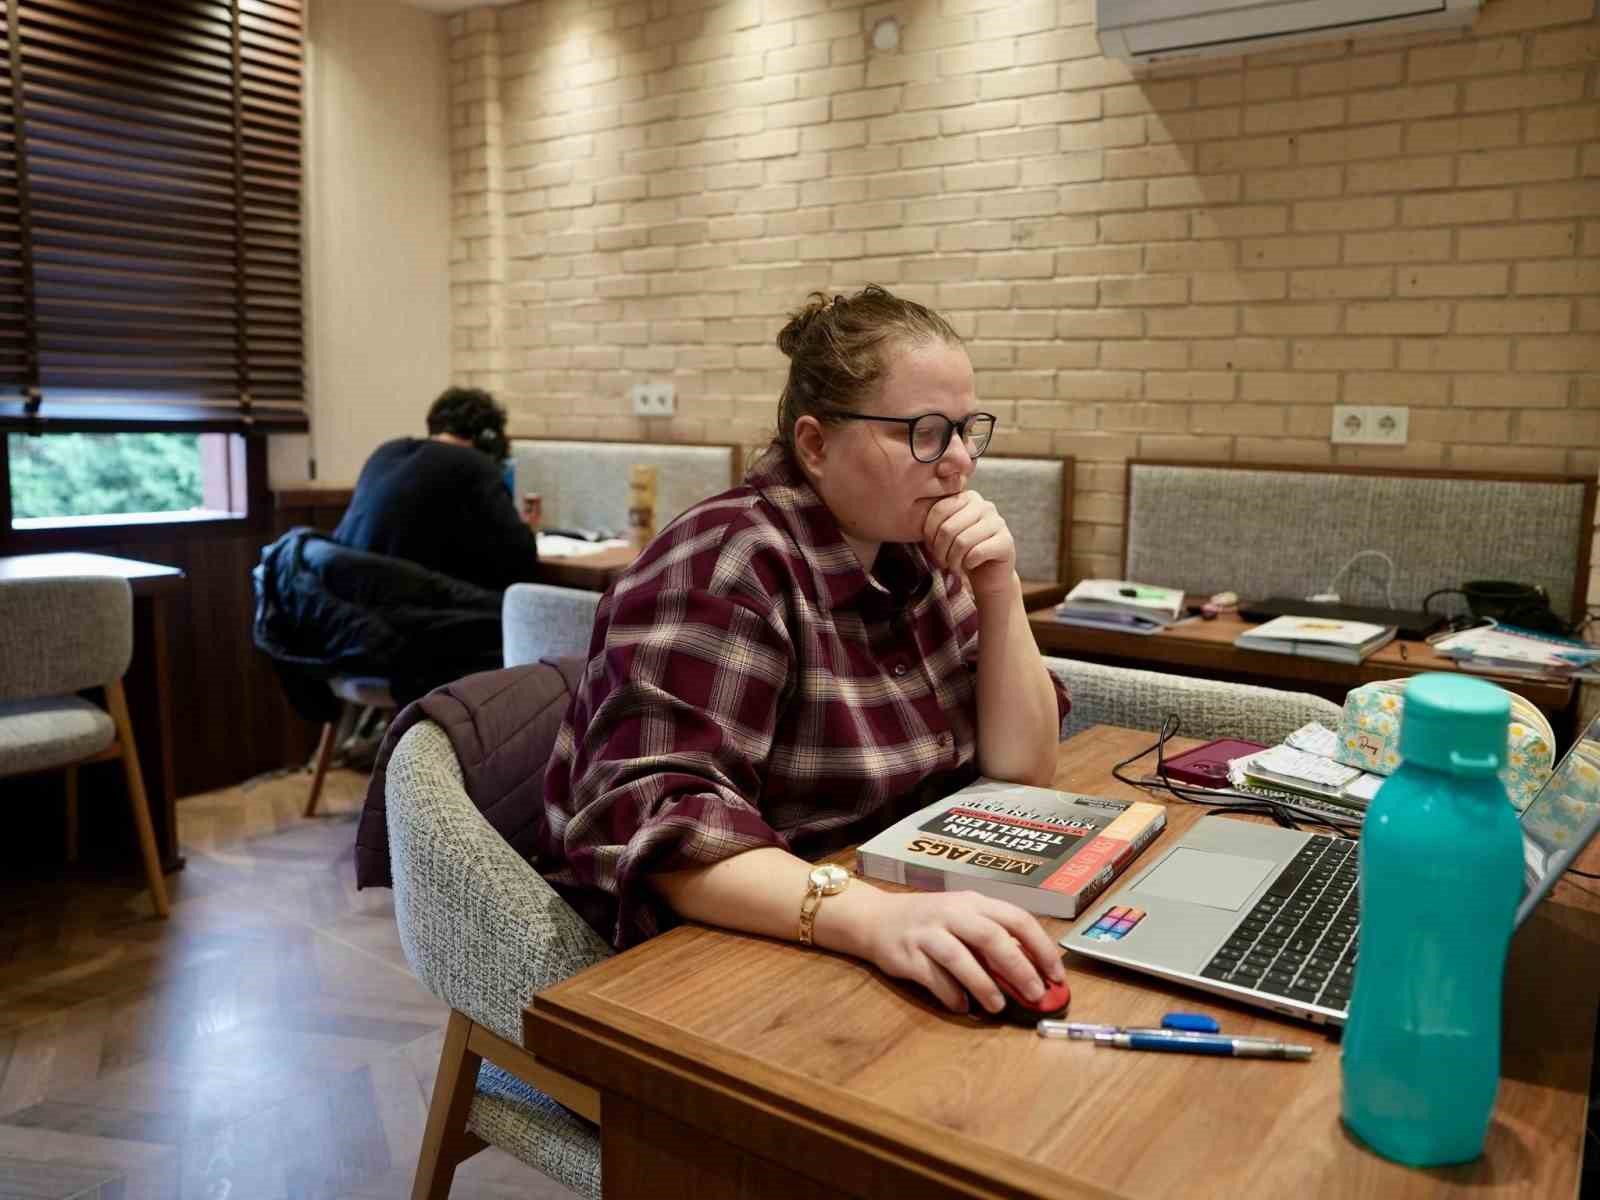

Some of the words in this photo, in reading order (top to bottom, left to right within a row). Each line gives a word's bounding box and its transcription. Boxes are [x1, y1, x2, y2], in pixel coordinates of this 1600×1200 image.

[943, 814, 1065, 845] TEMELLERİ
[1045, 817, 1097, 830] KONU
[942, 823, 1050, 853] EĞİTİMİN
[908, 839, 972, 861] AGS
[974, 853, 1034, 875] MEB
